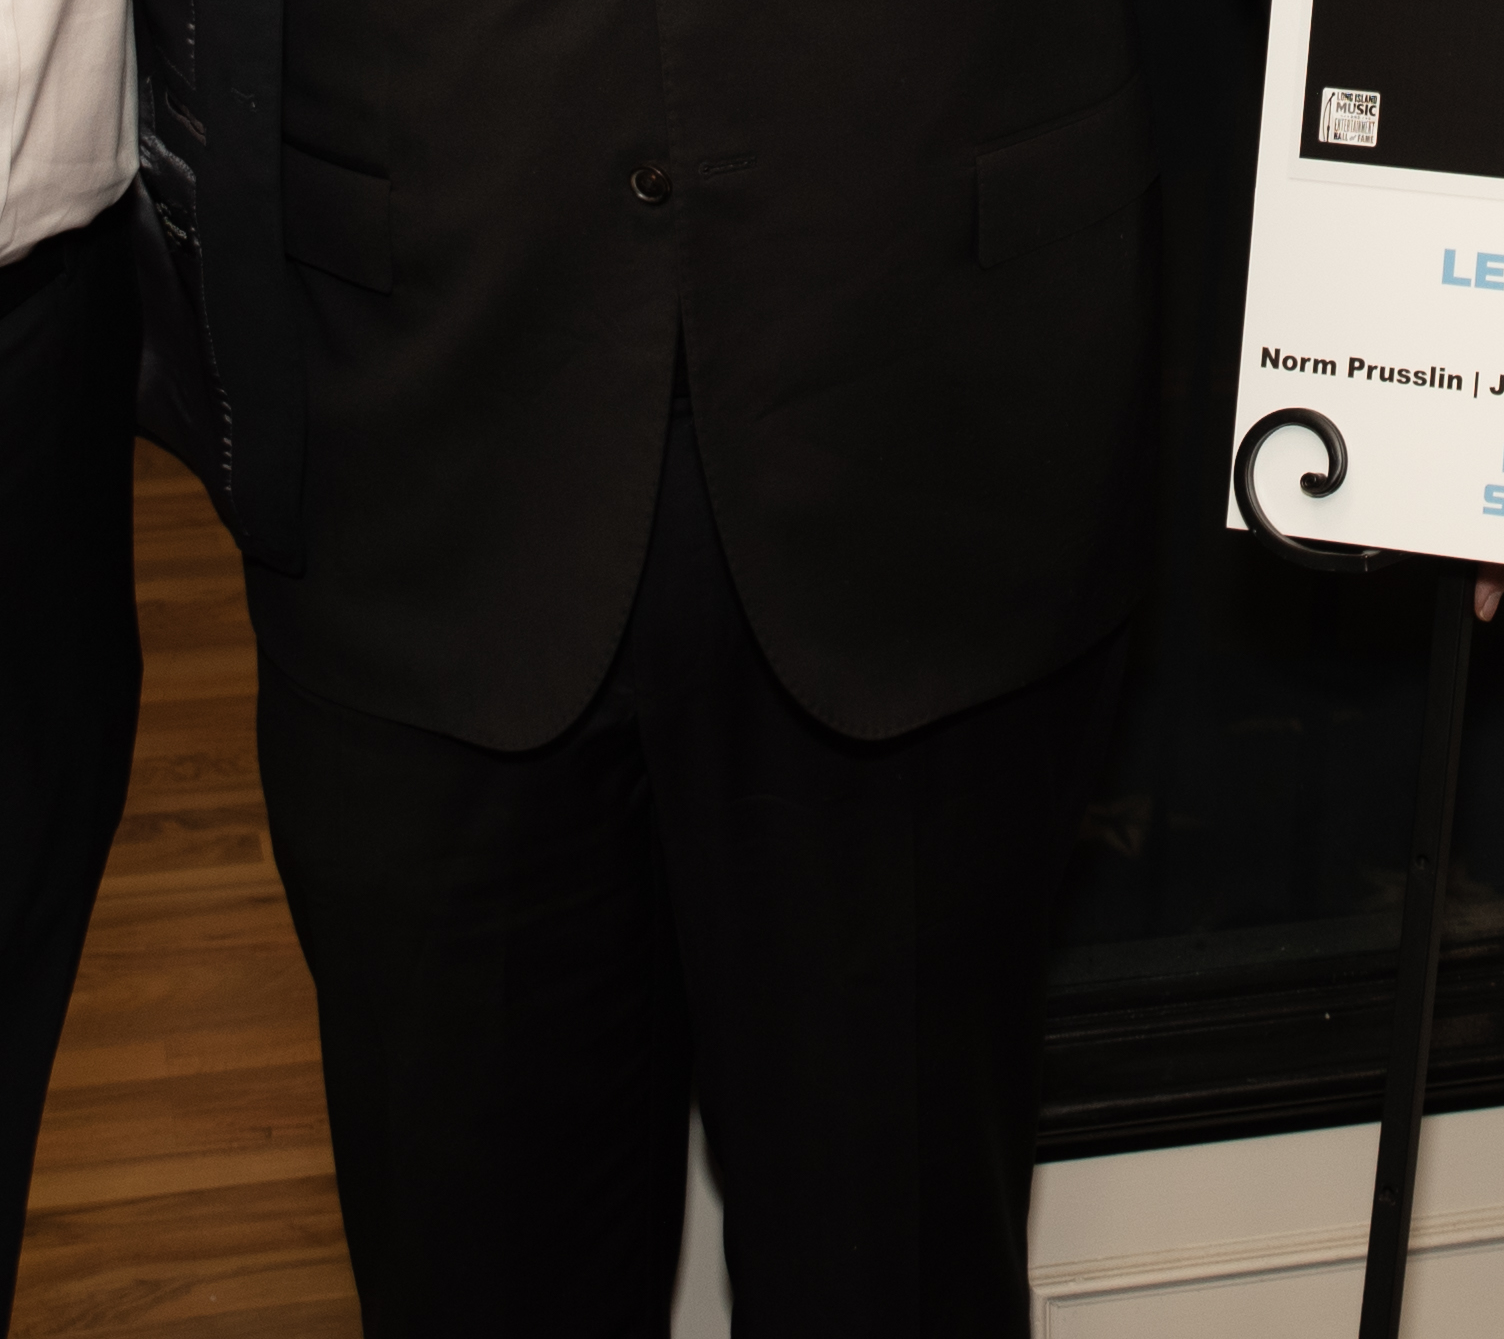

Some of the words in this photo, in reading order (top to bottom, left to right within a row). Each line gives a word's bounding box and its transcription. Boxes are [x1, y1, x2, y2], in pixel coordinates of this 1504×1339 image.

[1337, 92, 1353, 102] LONG
[1355, 94, 1377, 104] ISLAND
[1336, 102, 1376, 116] MUSIC
[1334, 132, 1348, 141] HALL
[1357, 134, 1374, 143] FAME
[1261, 347, 1336, 376] Norm
[1348, 356, 1462, 391] Prusslin
